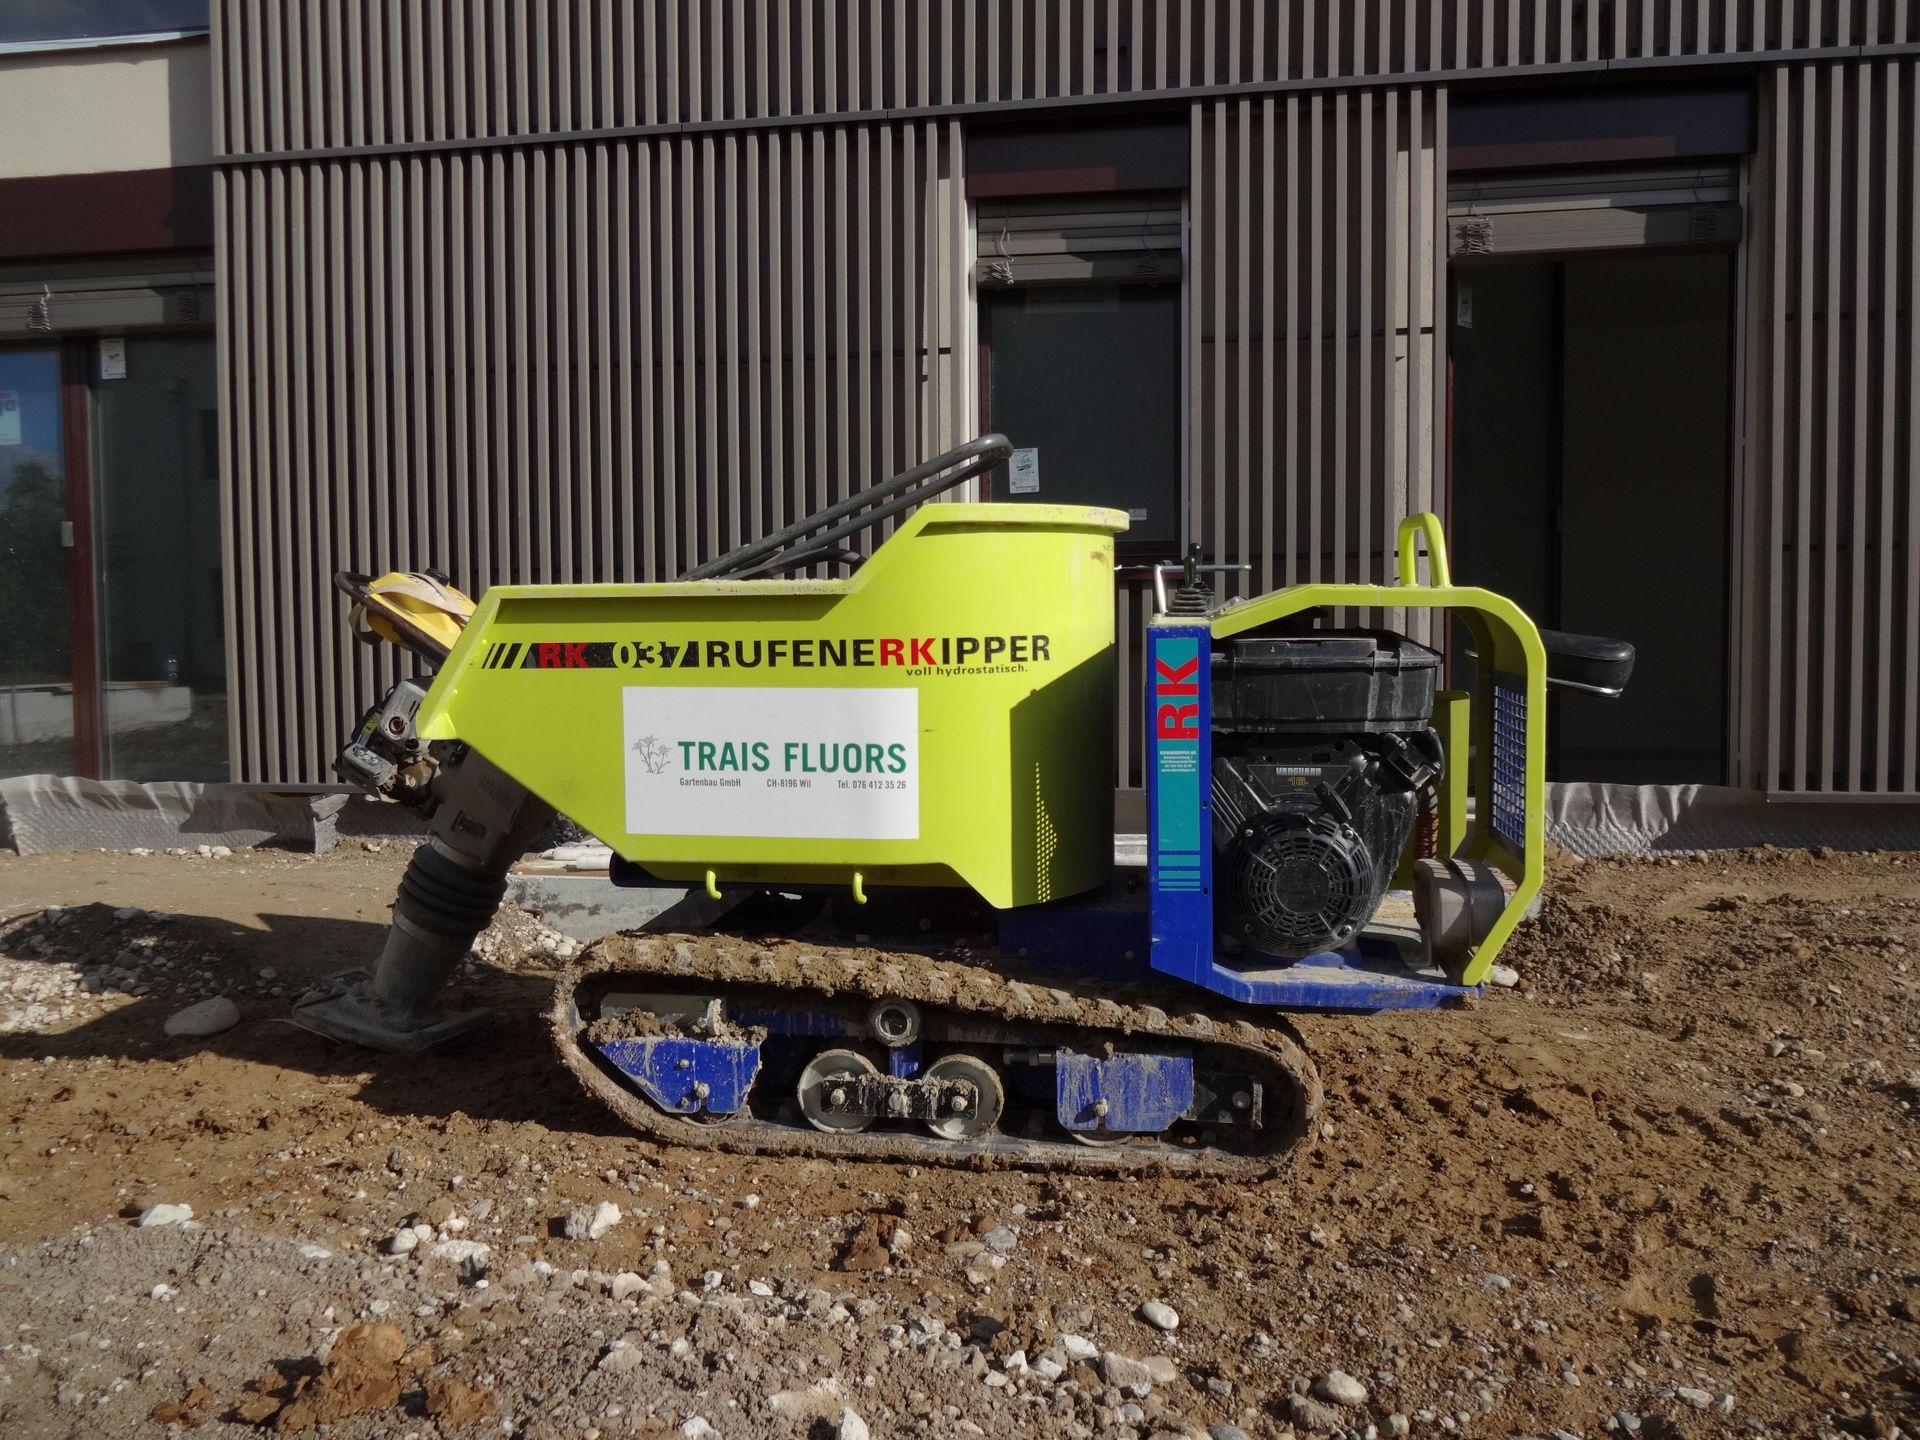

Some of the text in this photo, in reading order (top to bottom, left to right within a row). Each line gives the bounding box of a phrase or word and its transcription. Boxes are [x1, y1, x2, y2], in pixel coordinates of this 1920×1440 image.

[538, 634, 1051, 669] RK 037 RUFENERKIPPER
[906, 664, 1029, 677] voll hydrostatisch.
[1156, 657, 1199, 739] RK
[677, 741, 907, 774] TRAIS FLUORS
[679, 777, 907, 789] Gartenbau GmbH CH-8196 Wil Tel. 076 412 35 26
[1275, 767, 1322, 777] VANGUARD
